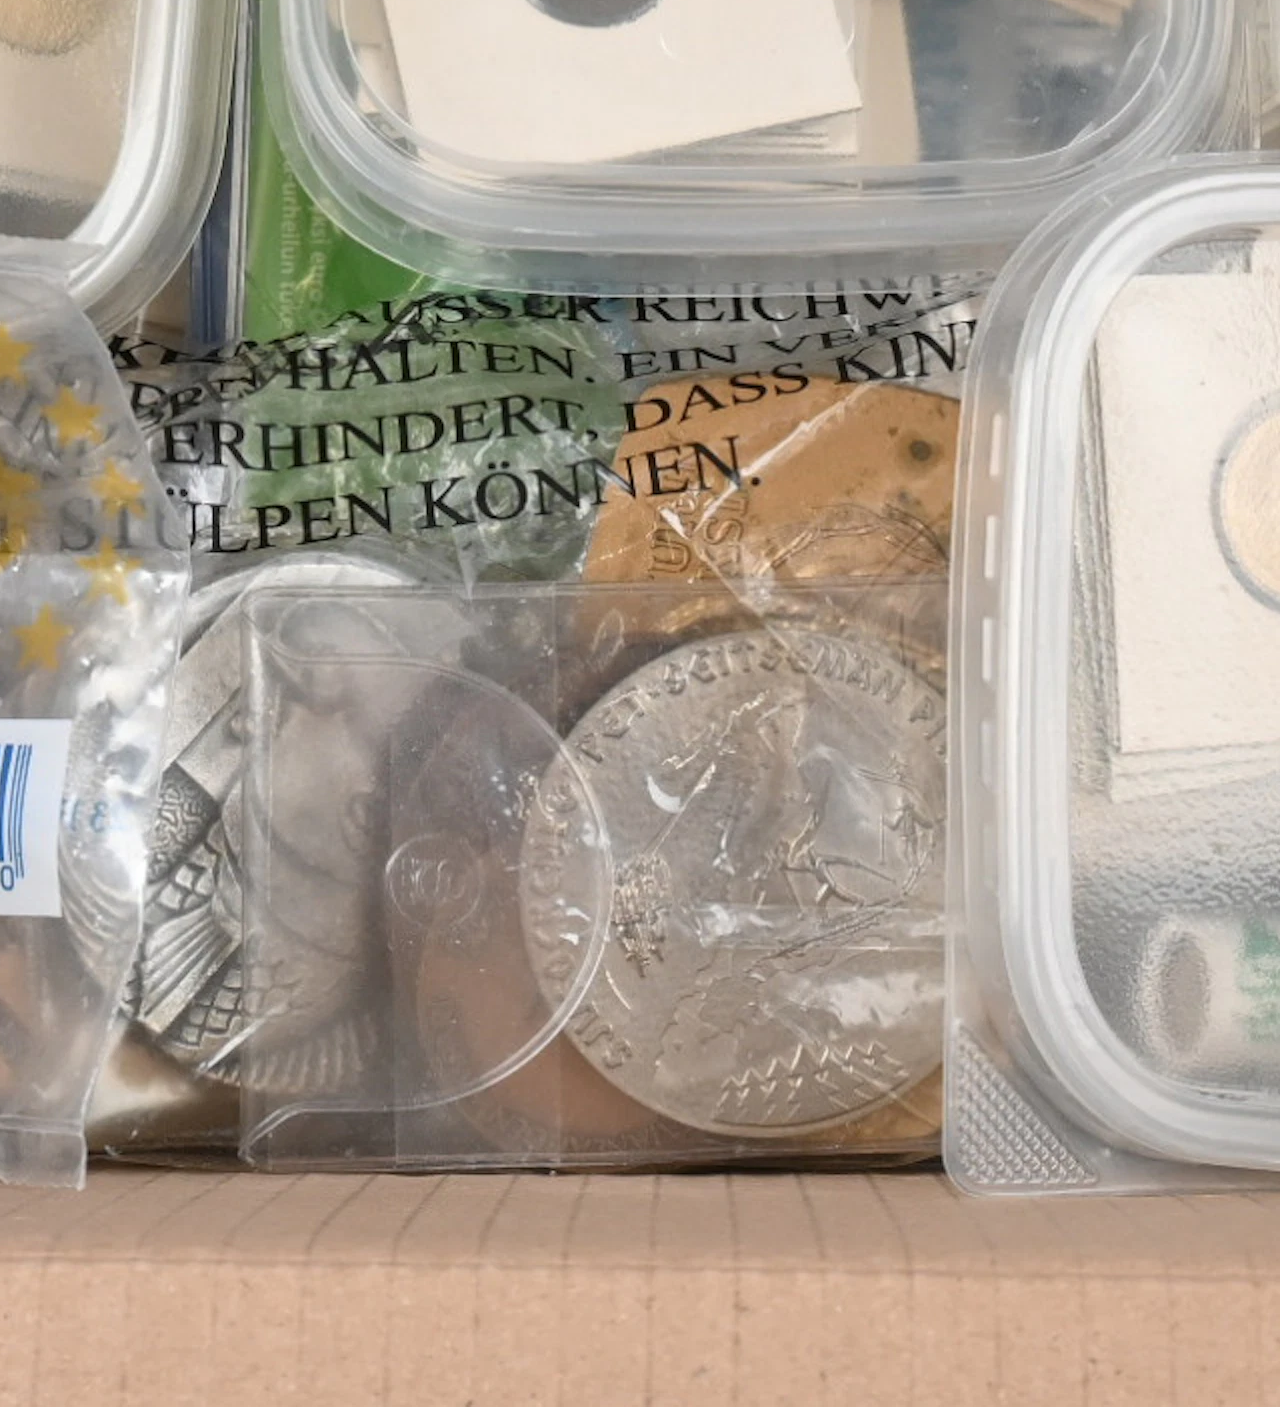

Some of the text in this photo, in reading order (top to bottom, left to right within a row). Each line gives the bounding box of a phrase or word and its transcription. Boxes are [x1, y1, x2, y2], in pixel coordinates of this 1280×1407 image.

[322, 288, 612, 329] AUSSER
[284, 337, 596, 391] HALTEN.
[618, 343, 738, 382] EIN
[158, 393, 599, 473] ERHINDERT,
[621, 361, 812, 434] DASS
[420, 435, 762, 530] KÖNNEN.
